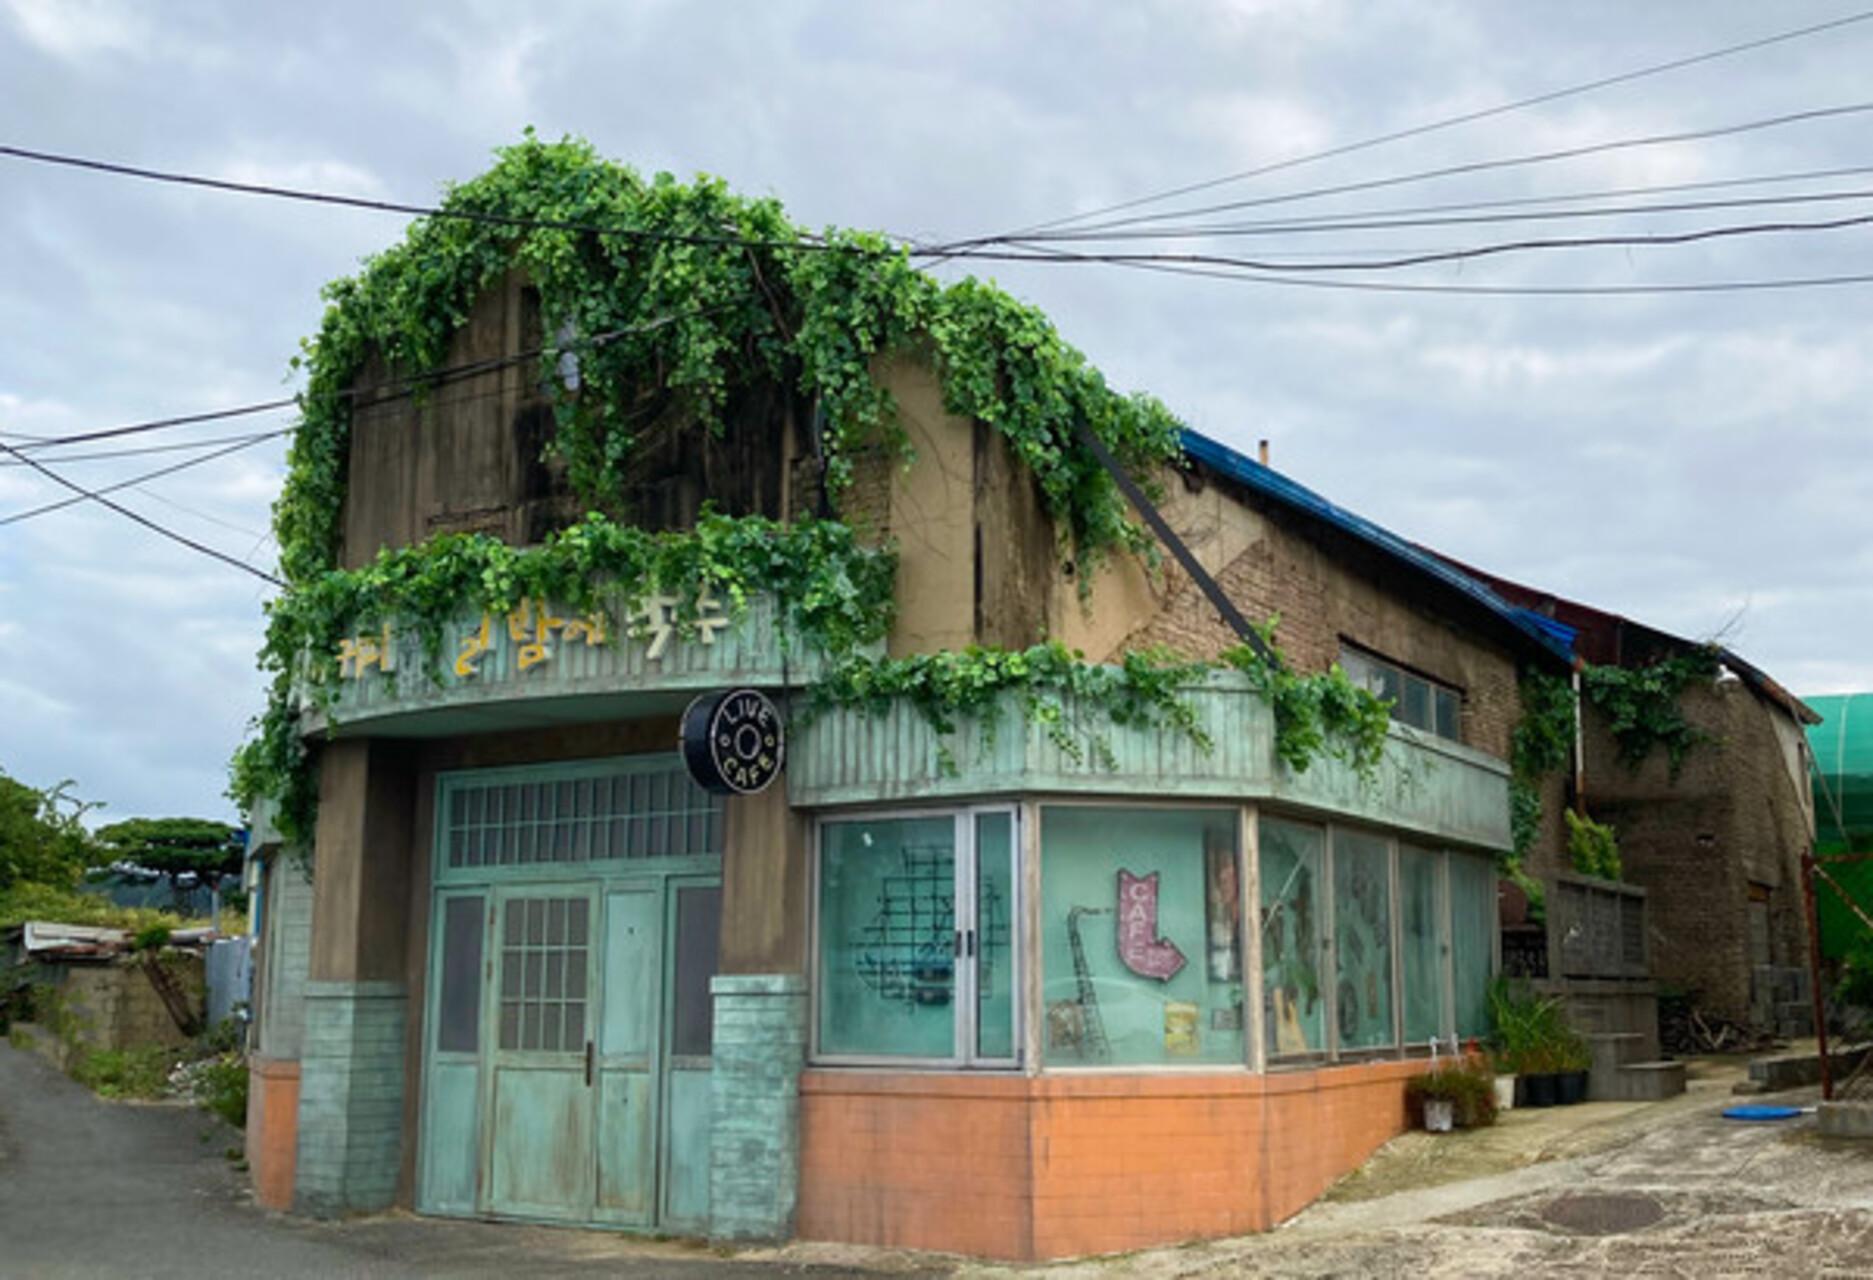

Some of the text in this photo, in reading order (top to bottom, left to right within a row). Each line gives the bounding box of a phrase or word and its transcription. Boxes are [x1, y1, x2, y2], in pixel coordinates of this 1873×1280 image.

[722, 698, 771, 728] LIVE
[723, 752, 775, 787] CAFE
[1128, 882, 1149, 961] CAFE
